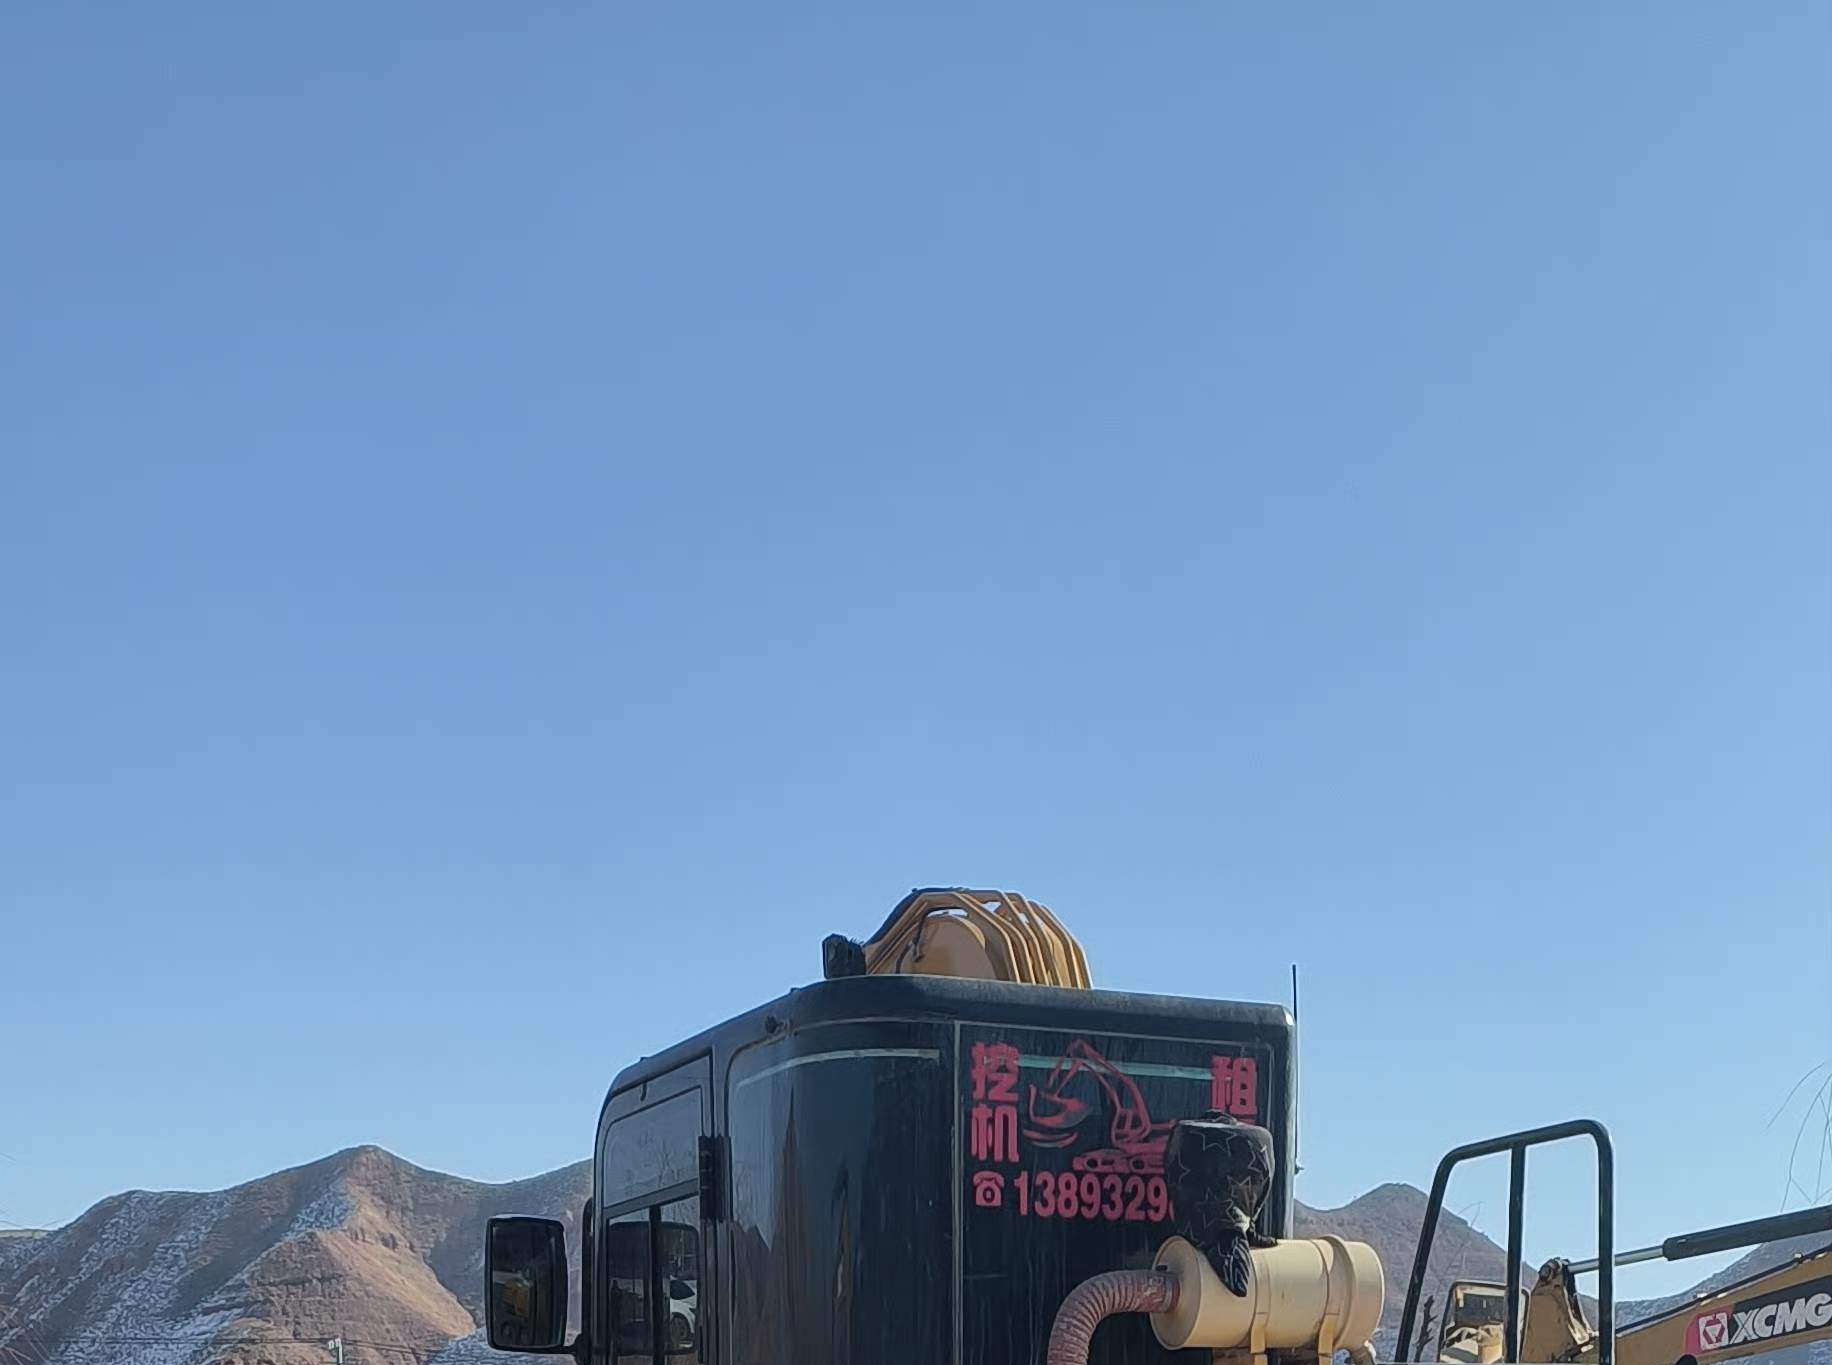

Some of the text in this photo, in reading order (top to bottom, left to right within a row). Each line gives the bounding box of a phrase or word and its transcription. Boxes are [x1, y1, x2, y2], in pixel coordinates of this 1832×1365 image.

[971, 1040, 1019, 1163] 挖机
[1210, 1055, 1258, 1125] 租
[1013, 1170, 1174, 1222] 1389329
[1730, 1292, 1832, 1345] XCMG
